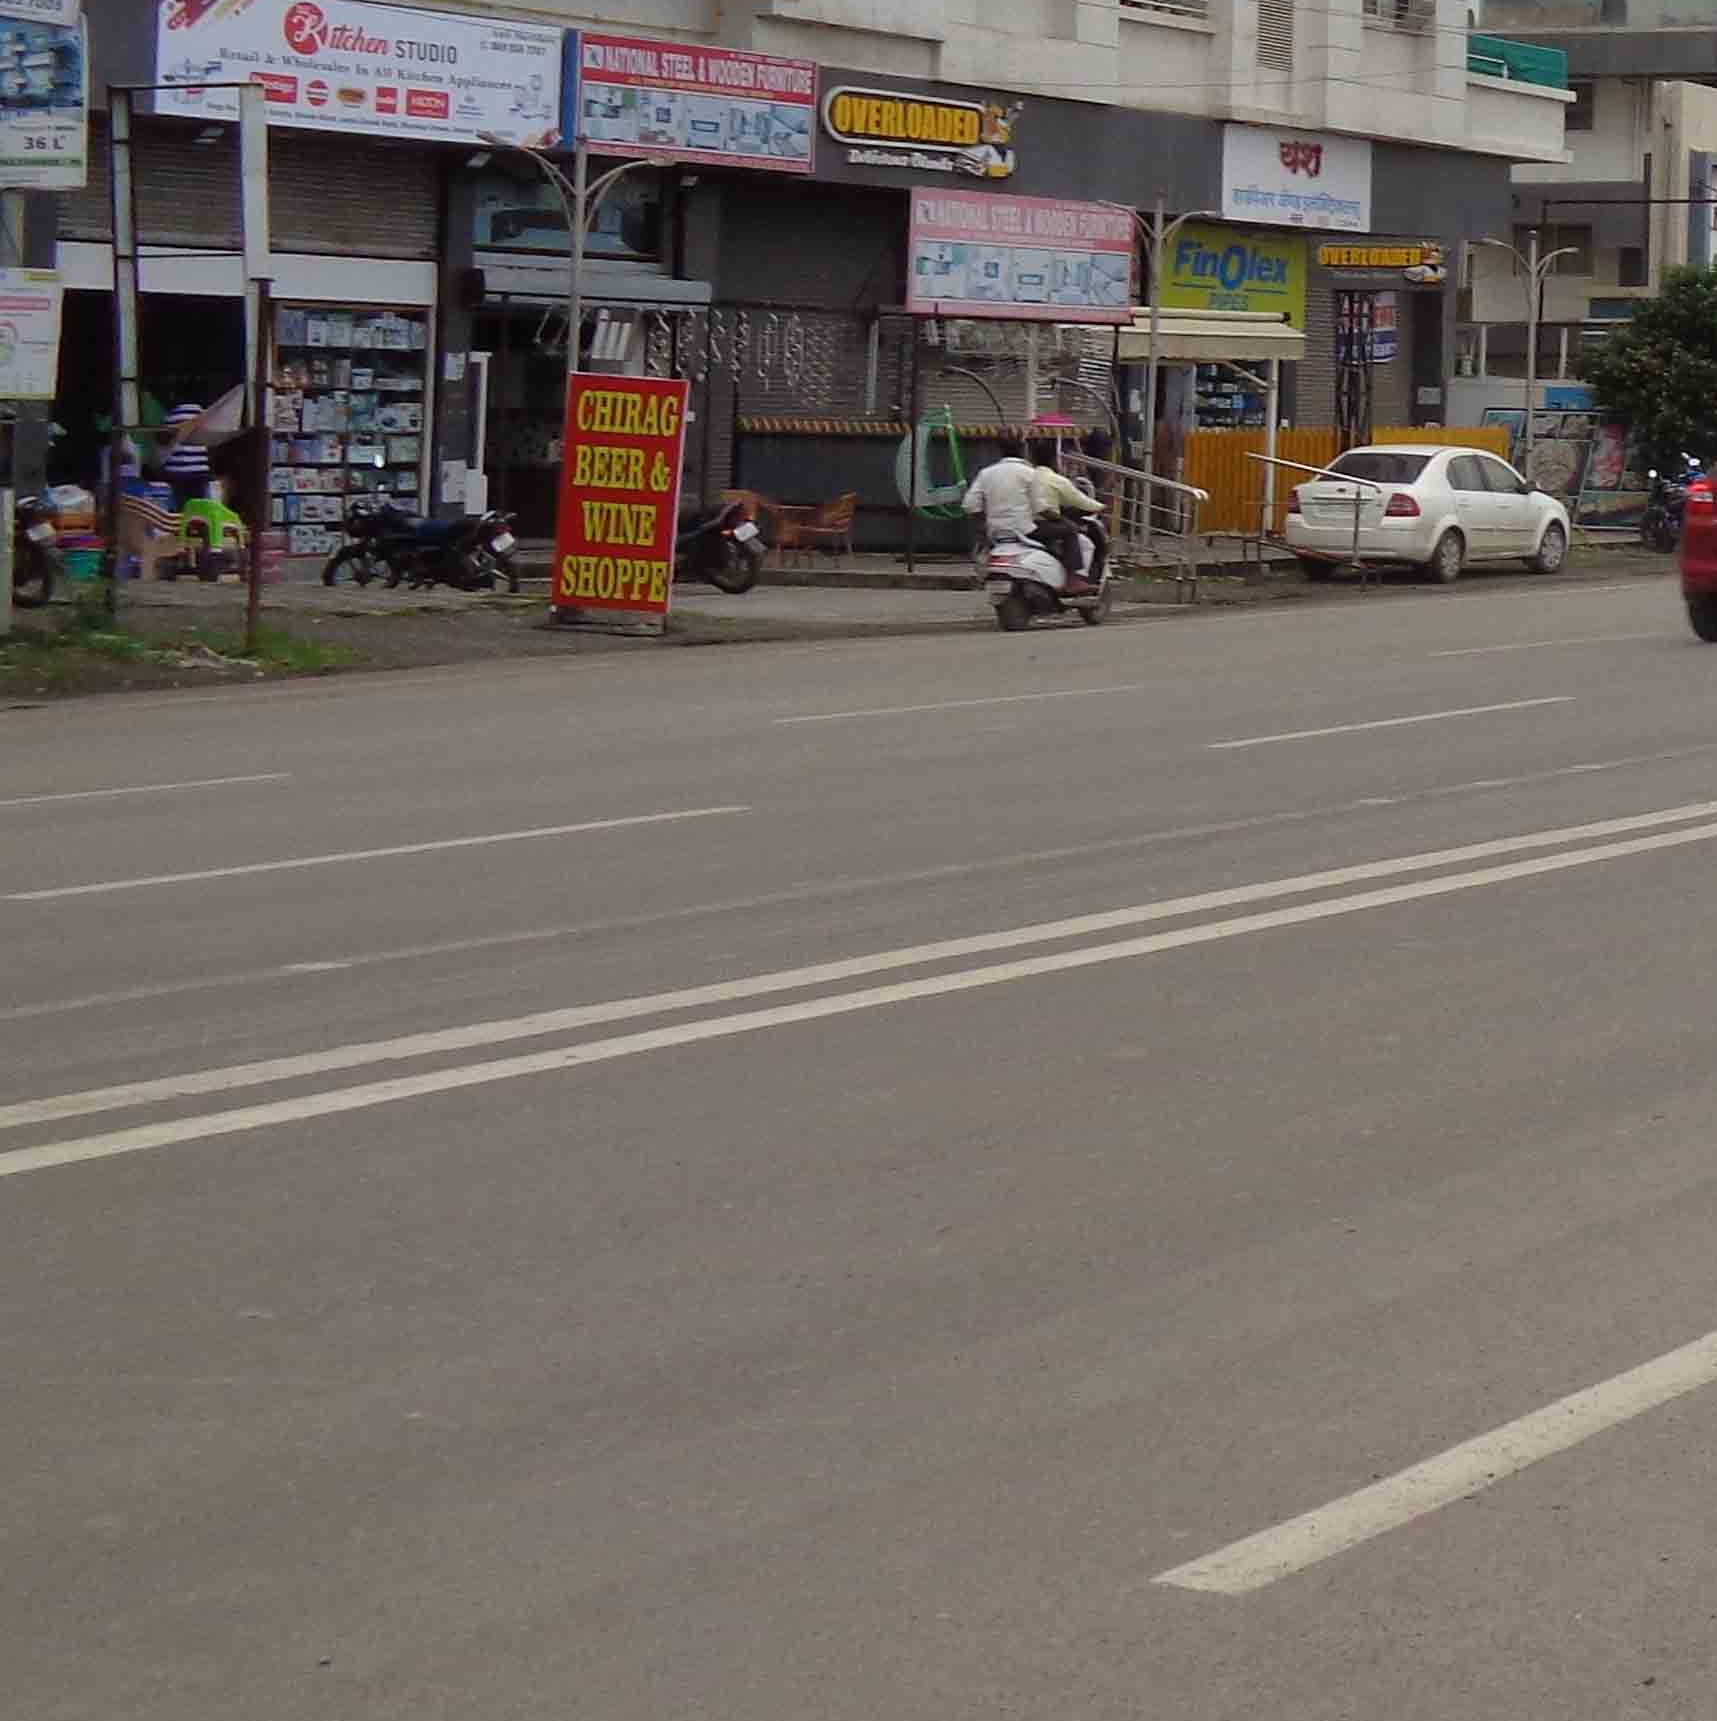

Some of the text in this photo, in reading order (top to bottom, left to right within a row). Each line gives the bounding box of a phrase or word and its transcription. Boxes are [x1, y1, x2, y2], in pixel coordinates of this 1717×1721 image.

[291, 13, 390, 56] Kitchen
[394, 39, 458, 65] STUDIO
[605, 44, 659, 77] NATIONAL
[662, 52, 696, 81] STEEL
[834, 94, 980, 145] OVERLOADED
[575, 389, 680, 437] CHIRAG
[572, 444, 671, 492] BEER &
[581, 500, 658, 547] WINE
[559, 554, 669, 603] SHOPPE
